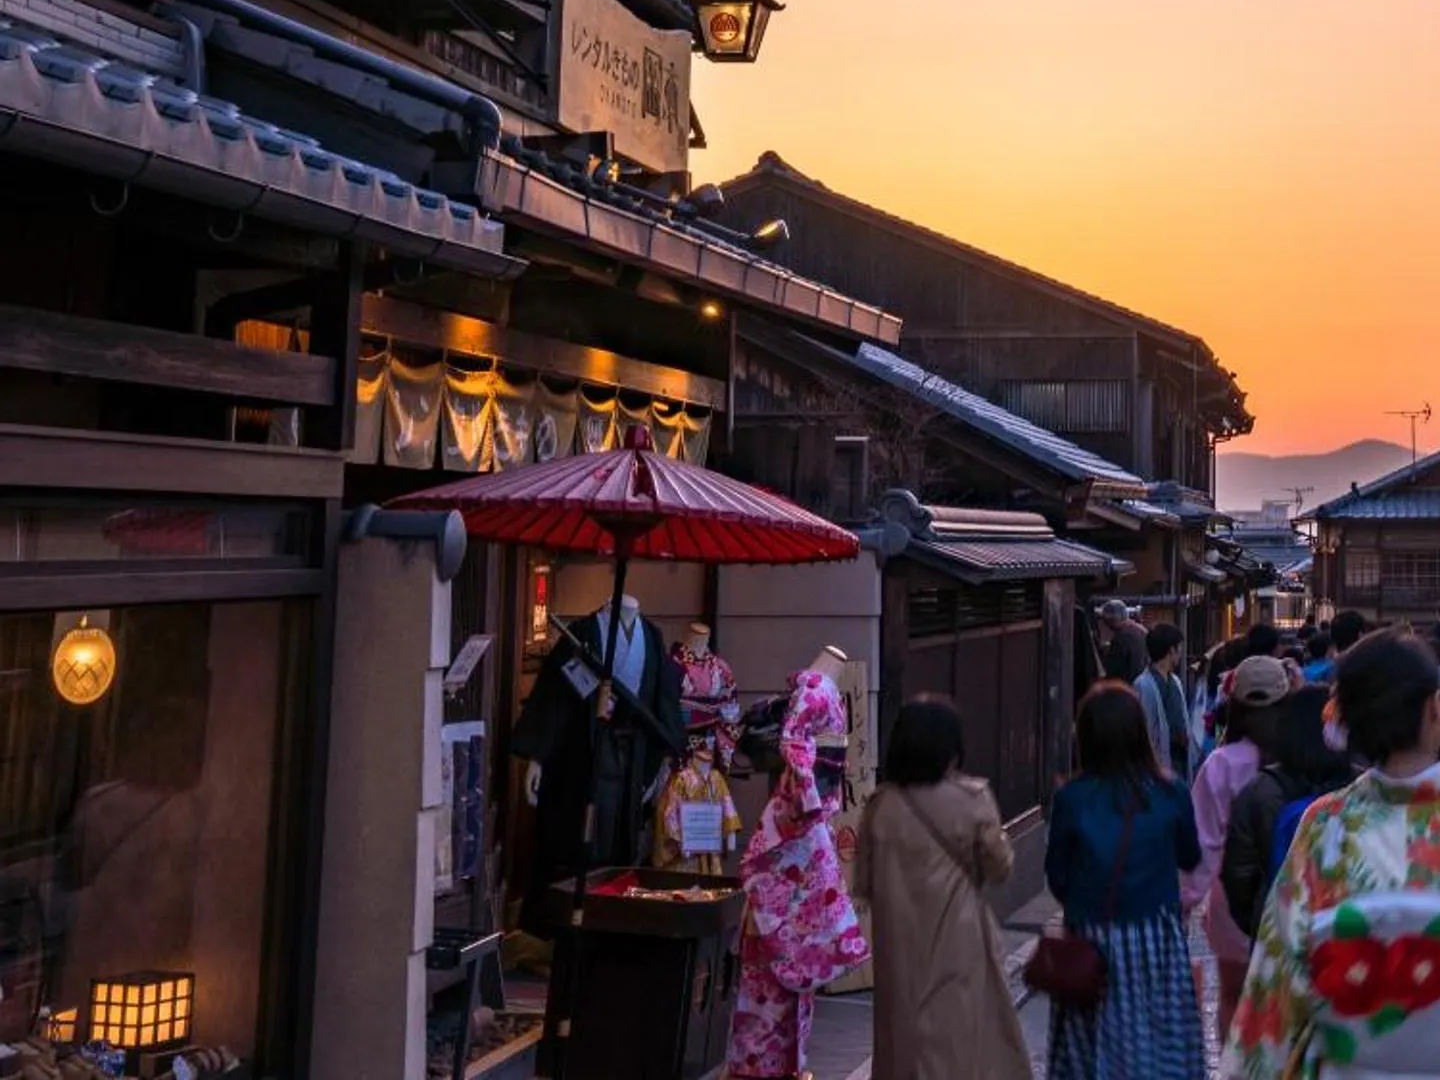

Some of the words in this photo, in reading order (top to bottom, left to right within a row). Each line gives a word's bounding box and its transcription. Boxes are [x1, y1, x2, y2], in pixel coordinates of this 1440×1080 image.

[571, 20, 641, 91] レンタルきもの
